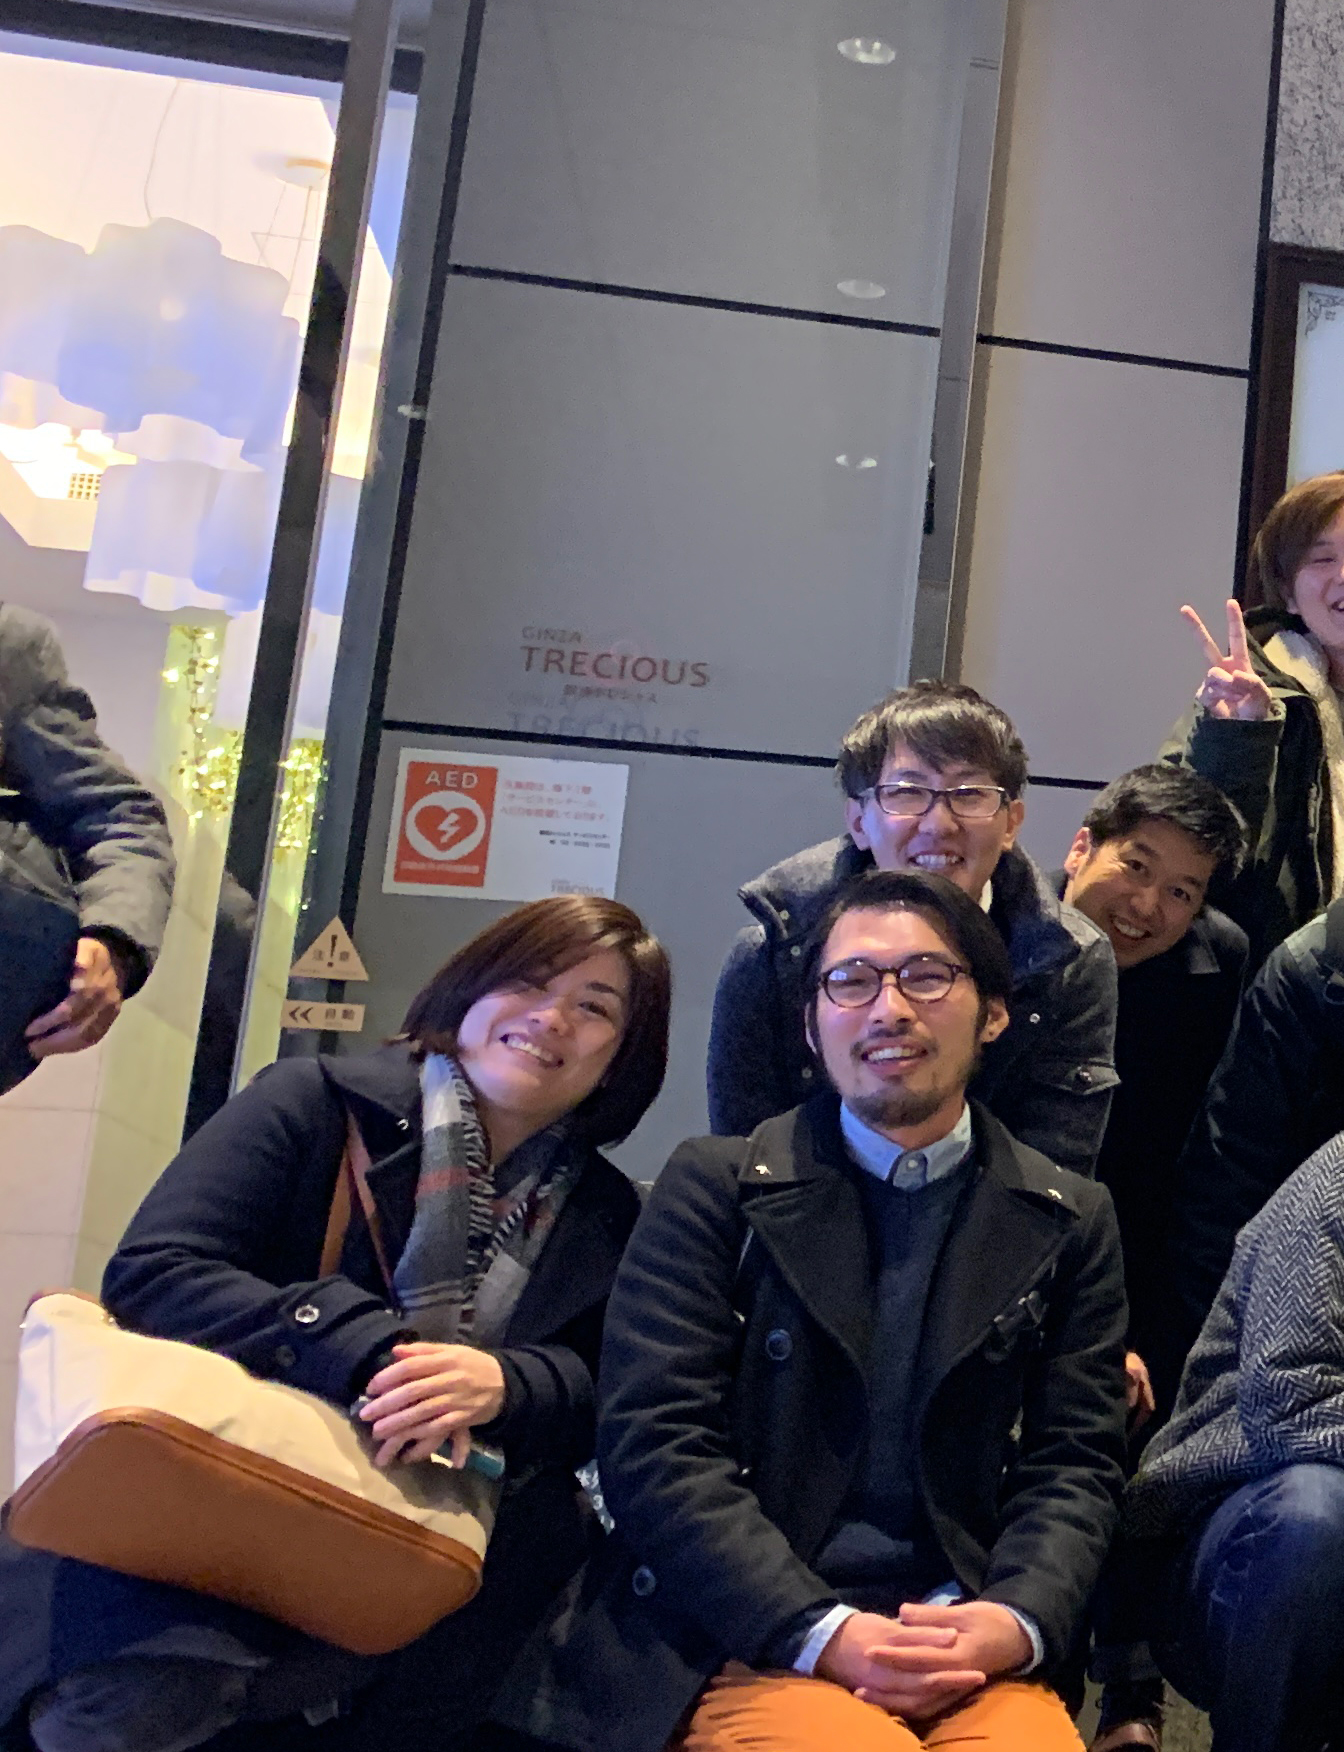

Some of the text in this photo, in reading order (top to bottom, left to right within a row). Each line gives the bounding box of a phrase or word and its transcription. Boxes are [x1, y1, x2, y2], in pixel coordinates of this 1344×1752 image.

[521, 625, 582, 644] GINZA
[520, 646, 710, 688] TRECIOUS
[425, 770, 479, 789] AED
